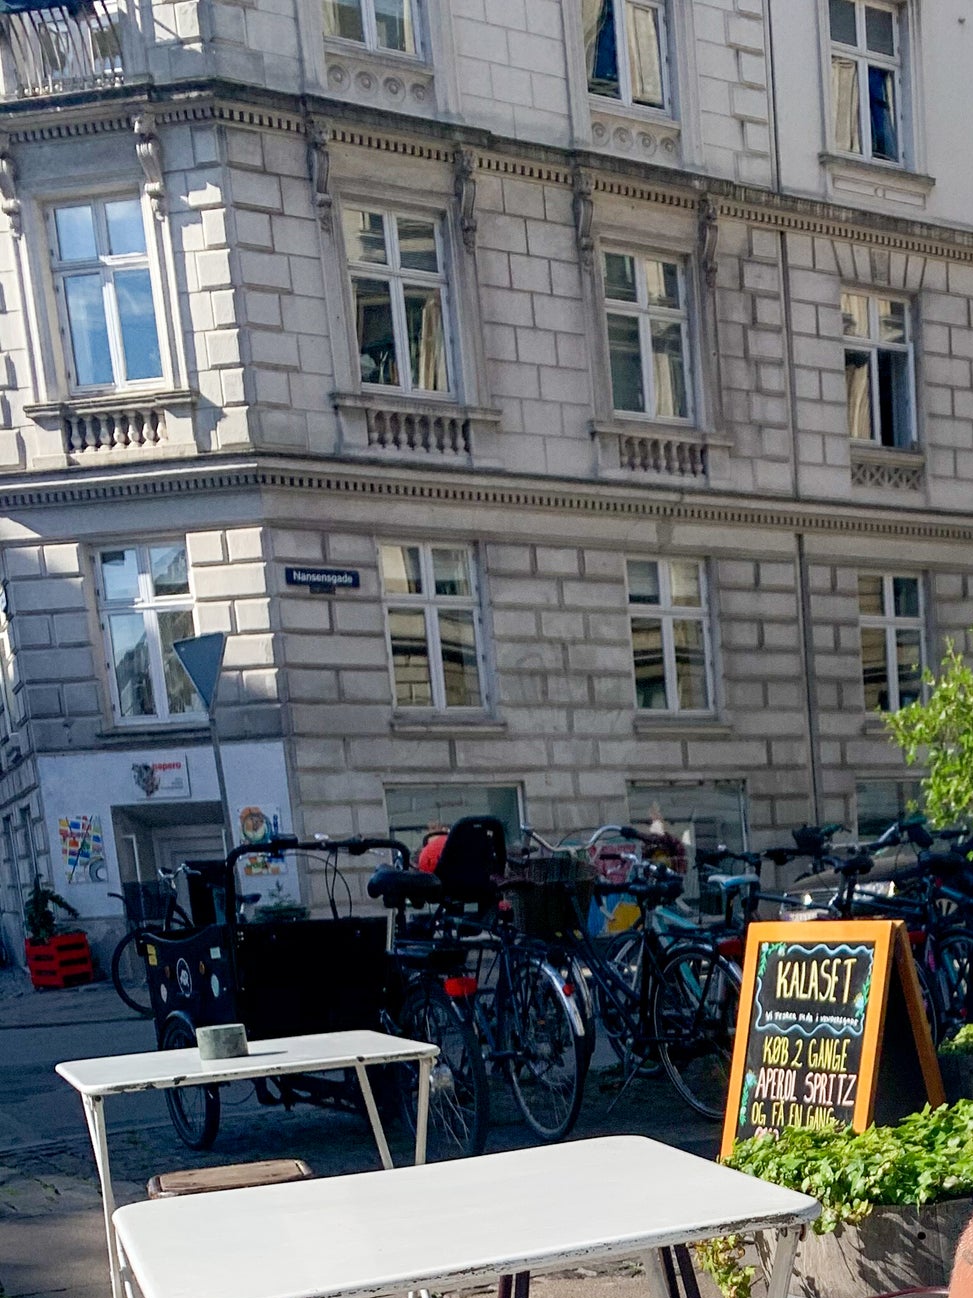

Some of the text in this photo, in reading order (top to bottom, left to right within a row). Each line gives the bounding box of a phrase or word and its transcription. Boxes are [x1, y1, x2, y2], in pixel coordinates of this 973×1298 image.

[292, 570, 353, 584] Nansensgade
[776, 957, 857, 1004] KALASET
[763, 1036, 851, 1072] KØB 2 GANGE
[755, 1066, 857, 1107] APEROL SPRITZ
[751, 1101, 766, 1126] OG
[771, 1100, 785, 1127] FÅ
[788, 1102, 803, 1129] EN
